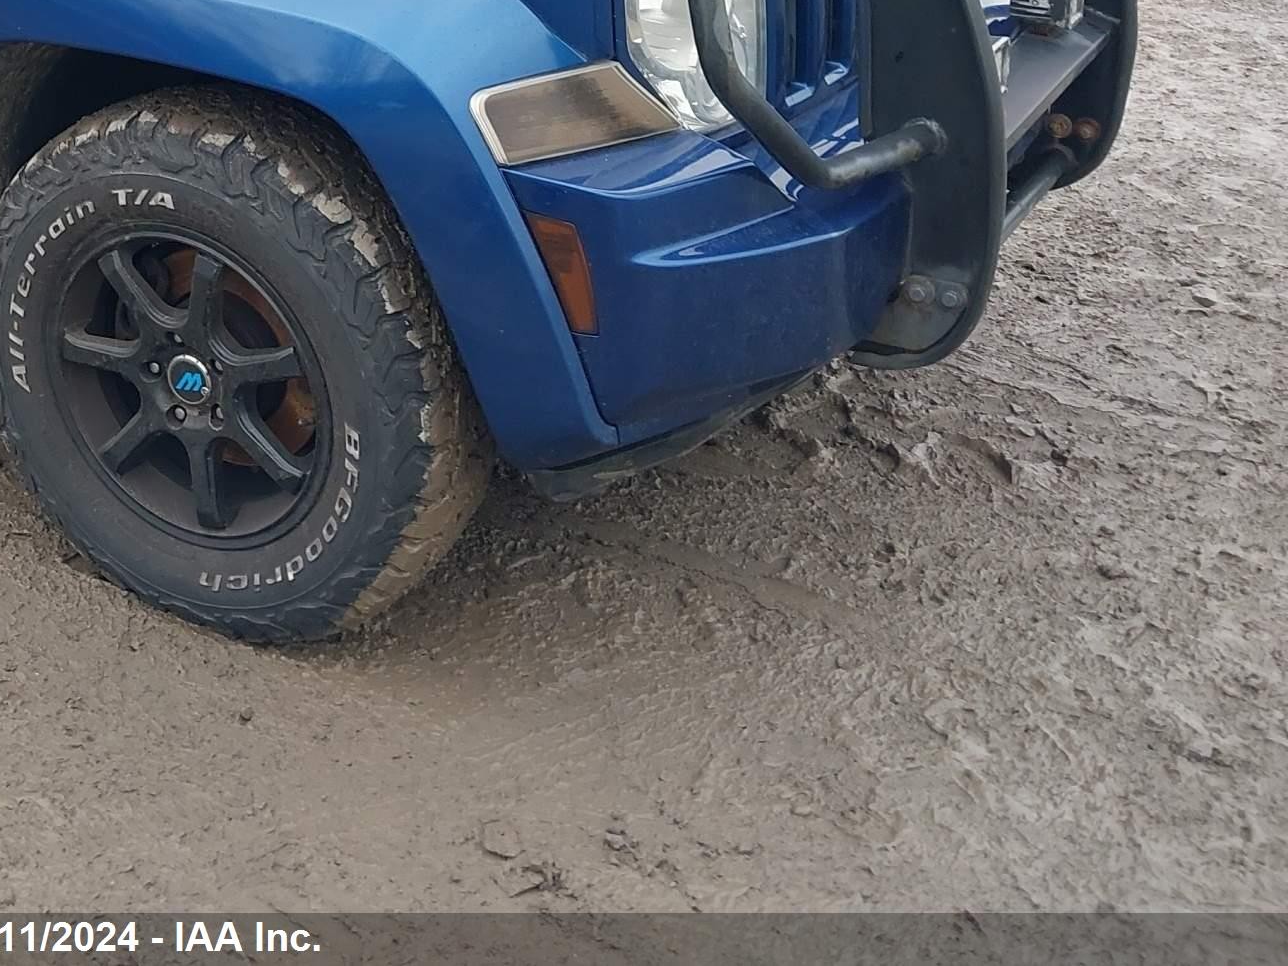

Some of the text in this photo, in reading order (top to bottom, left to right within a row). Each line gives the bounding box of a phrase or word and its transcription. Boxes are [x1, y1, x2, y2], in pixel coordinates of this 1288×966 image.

[10, 188, 176, 394] All-Terrain T/A
[199, 421, 362, 593] BFGoodrich
